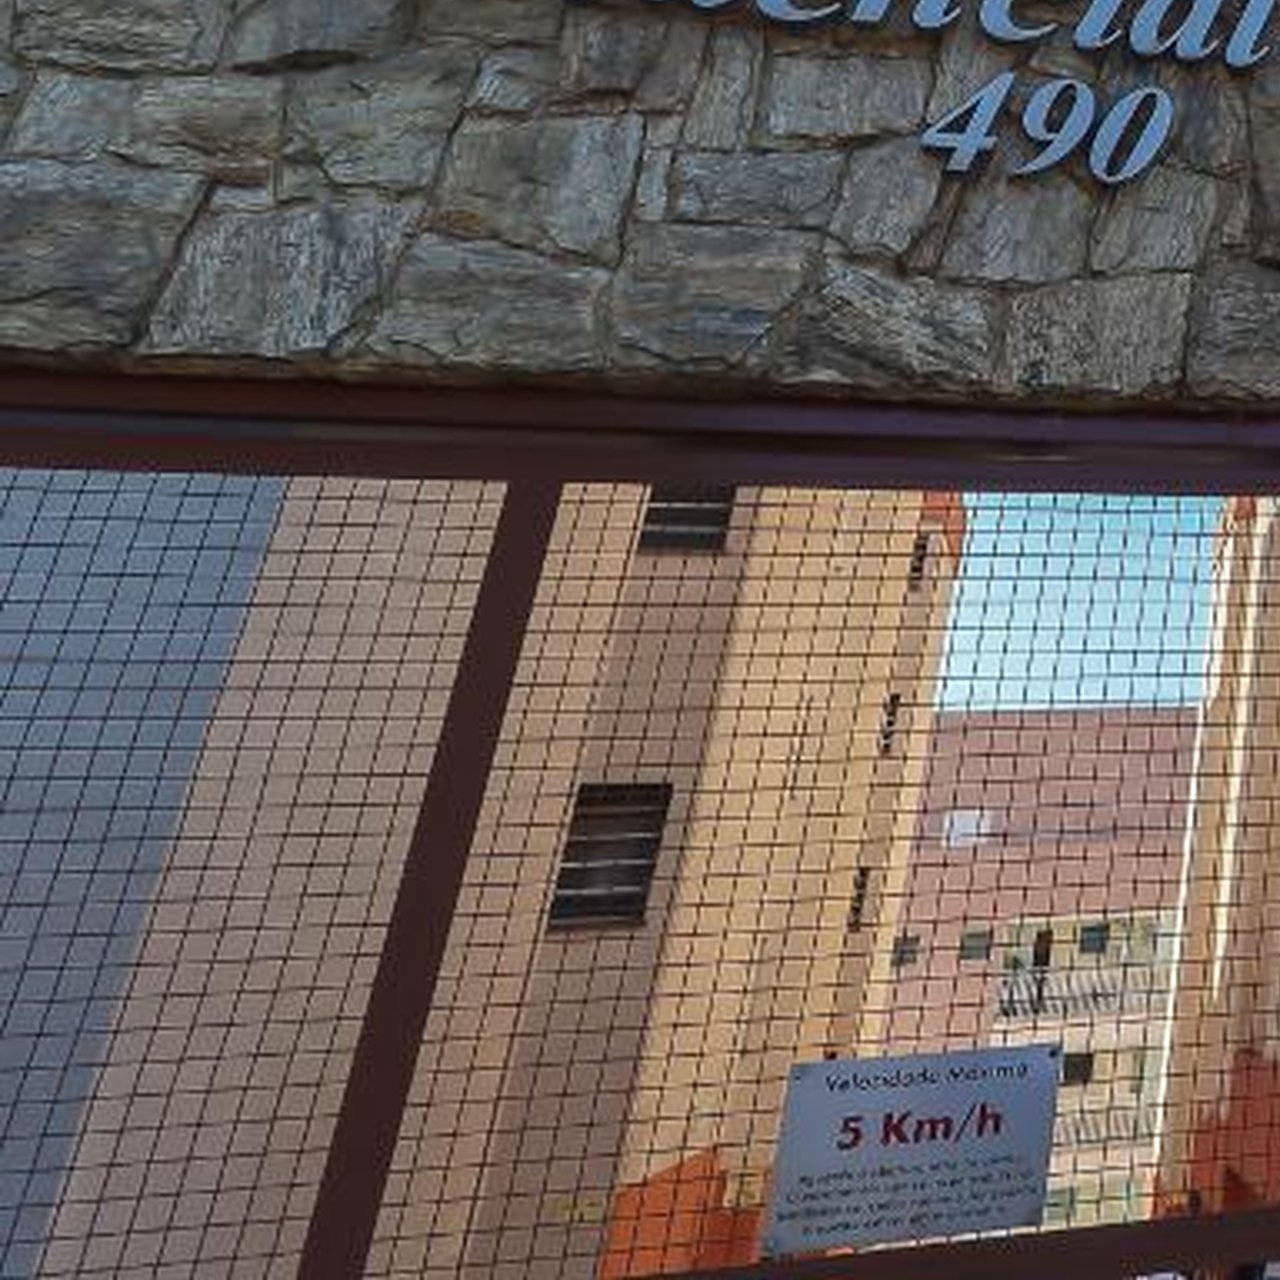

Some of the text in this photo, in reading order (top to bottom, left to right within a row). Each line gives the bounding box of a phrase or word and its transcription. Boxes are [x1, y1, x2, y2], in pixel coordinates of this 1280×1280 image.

[919, 69, 1176, 184] 490
[837, 1101, 1003, 1151] 5 Km/h
